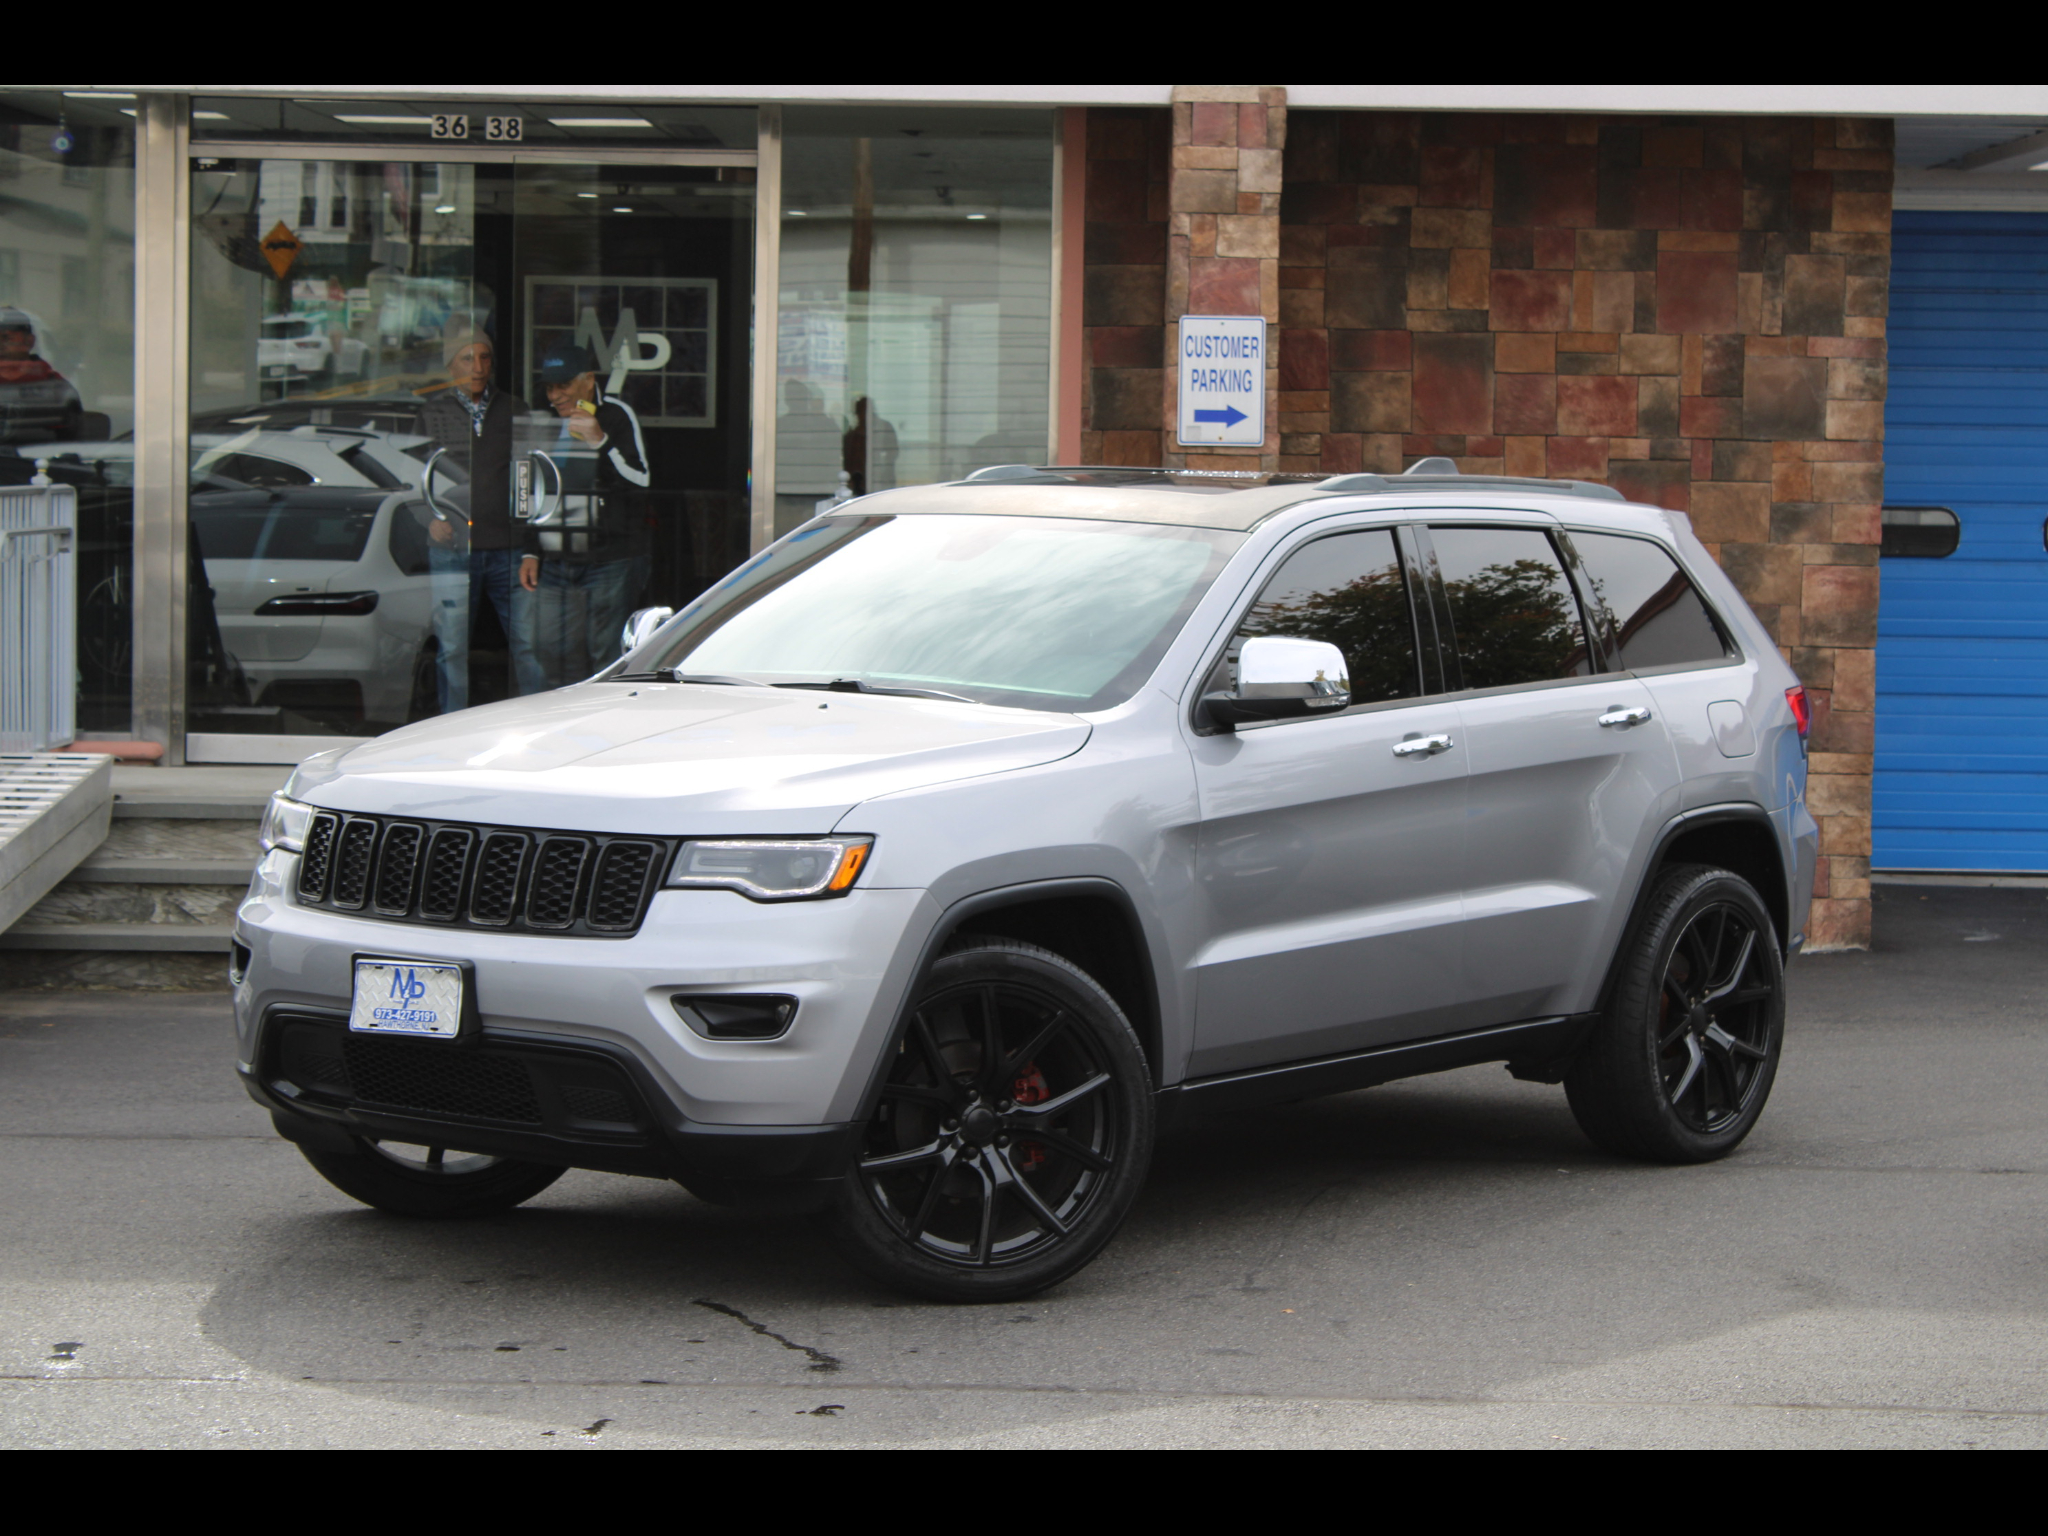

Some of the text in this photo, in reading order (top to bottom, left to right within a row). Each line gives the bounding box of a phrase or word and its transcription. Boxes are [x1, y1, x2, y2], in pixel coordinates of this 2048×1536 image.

[434, 115, 520, 139] 36 38
[1185, 335, 1259, 358] CUSTOMER
[1191, 369, 1252, 393] PARKING
[519, 465, 528, 512] PUSH
[375, 1008, 434, 1022] 973-427-9191
